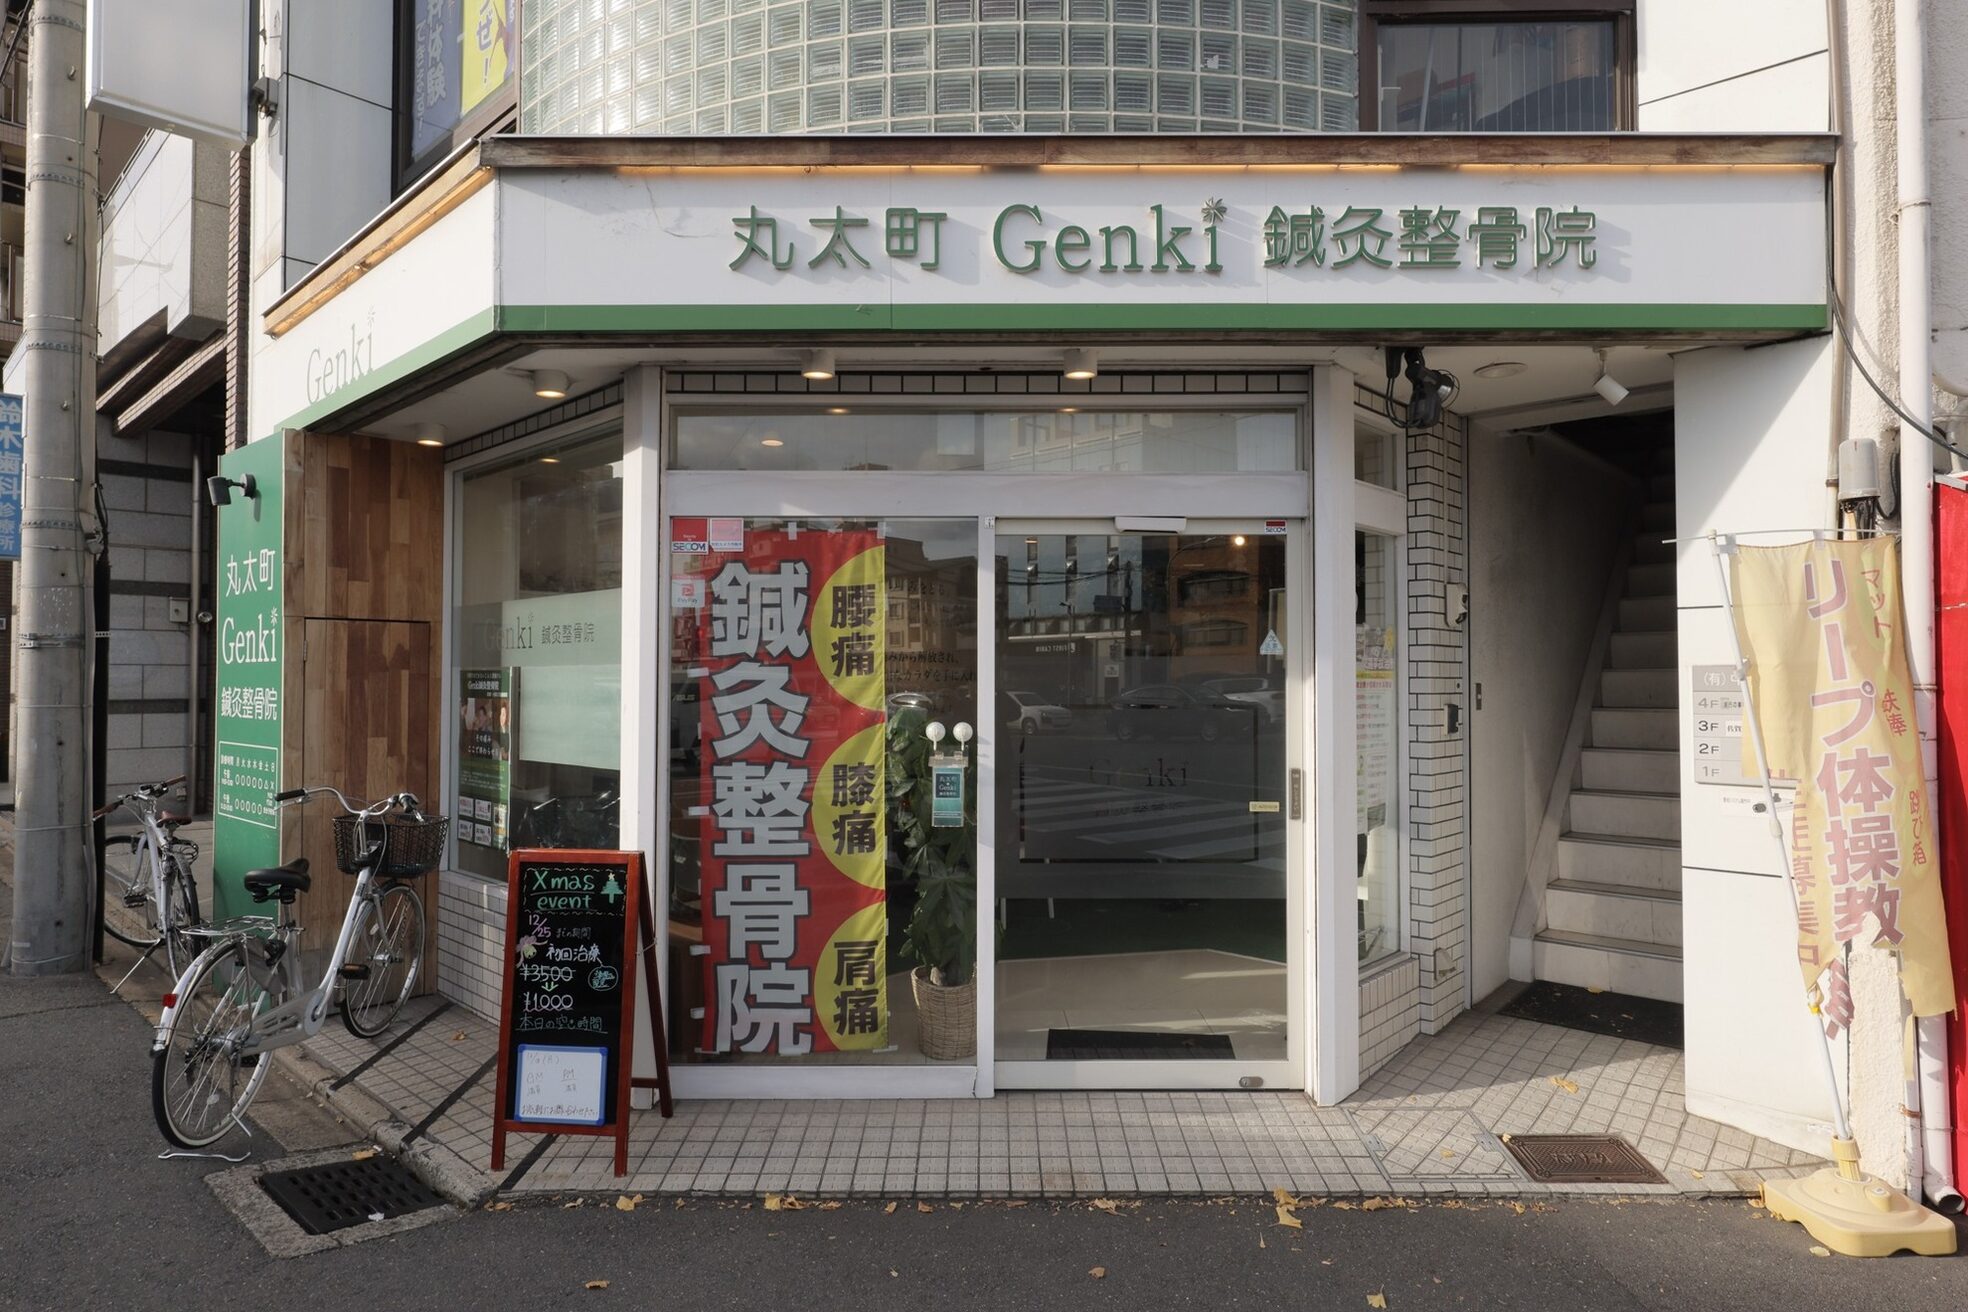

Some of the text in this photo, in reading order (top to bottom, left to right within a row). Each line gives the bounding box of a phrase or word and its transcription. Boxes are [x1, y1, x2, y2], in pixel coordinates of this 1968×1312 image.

[728, 197, 1598, 273] 丸太町 Genki 鍼灸整骨院
[306, 305, 376, 405] Genki
[672, 542, 706, 551] SECOM
[225, 548, 276, 598] 丸太町
[1860, 568, 1893, 640] マット
[222, 606, 279, 665] Genki
[541, 622, 595, 645] 鍼灸整骨院
[831, 584, 876, 677] 腰痛
[221, 686, 278, 721] 鍼灸整骨院
[1698, 697, 1719, 709] 4F
[1881, 688, 1908, 738] 鉄棒
[1698, 720, 1719, 732] 3F
[1699, 743, 1720, 755] 2F
[1702, 766, 1721, 777] 1F
[709, 559, 812, 1056] 鍼灸整骨院
[831, 762, 876, 856] 膝痛
[1908, 789, 1928, 868] 跳び箱
[532, 870, 595, 891] Xmas
[537, 894, 593, 910] event
[545, 943, 601, 964] 初回治療
[523, 991, 574, 1010] ¥1000
[833, 940, 879, 1037] 肩痛
